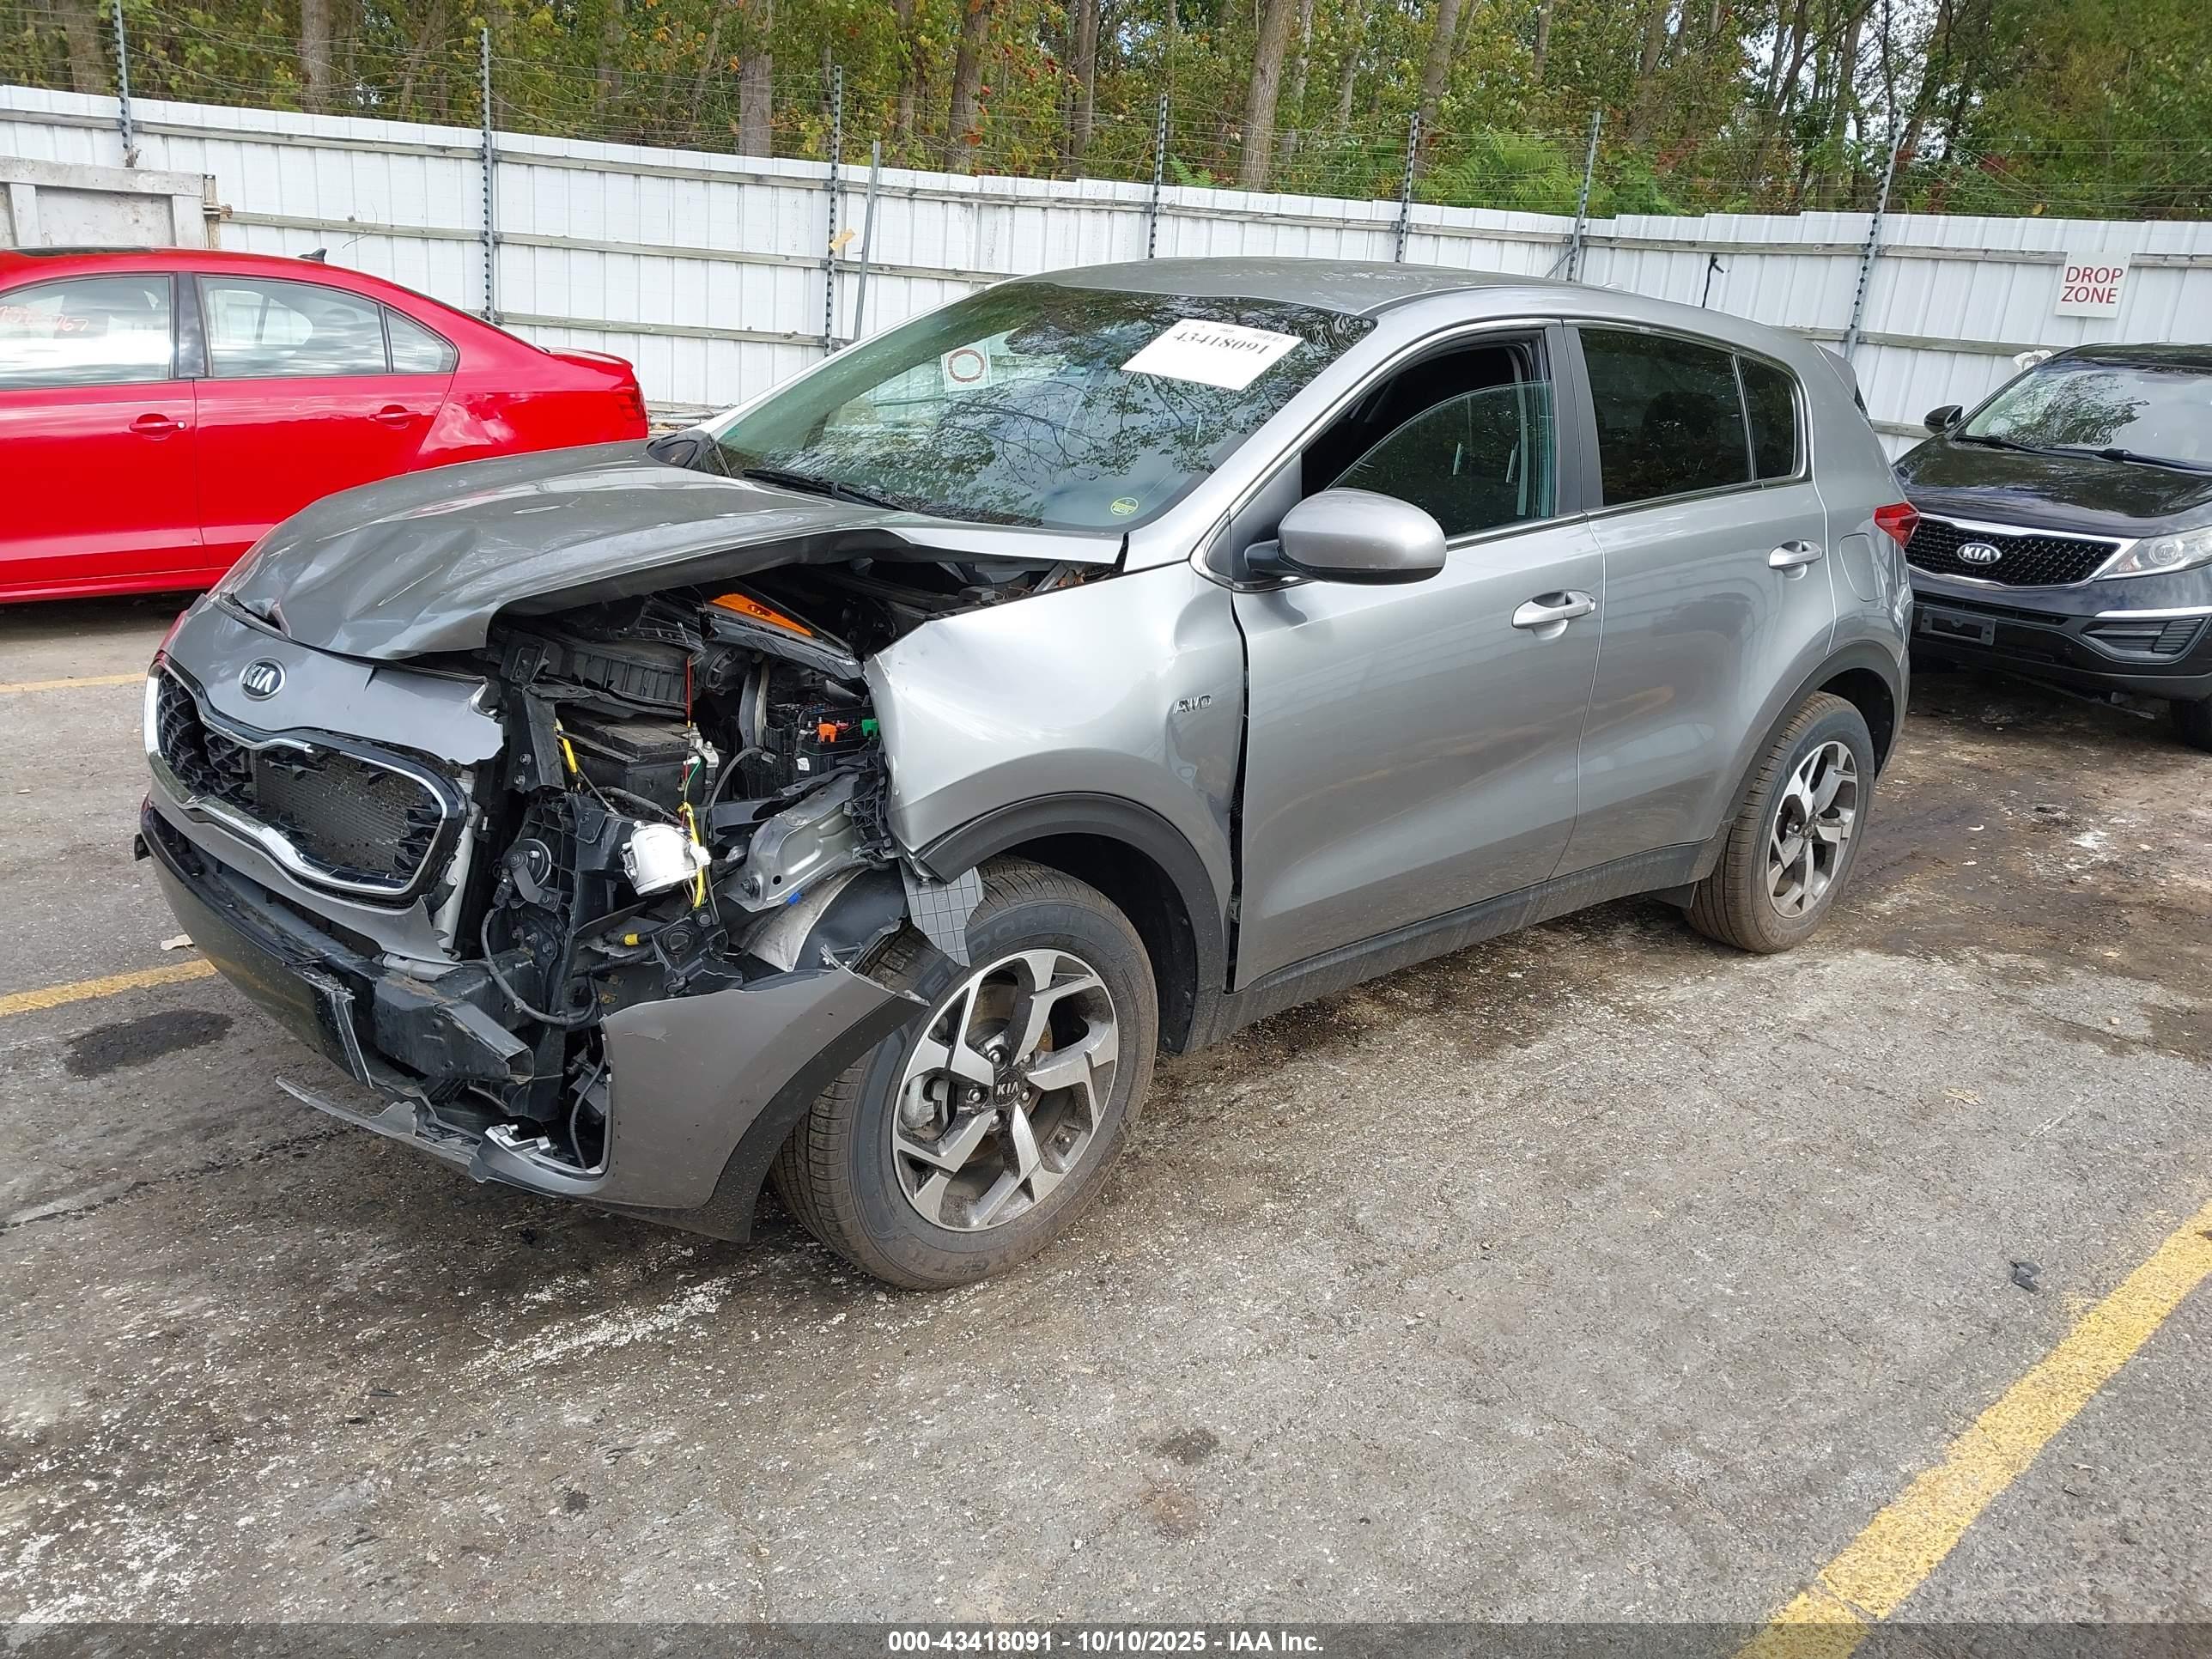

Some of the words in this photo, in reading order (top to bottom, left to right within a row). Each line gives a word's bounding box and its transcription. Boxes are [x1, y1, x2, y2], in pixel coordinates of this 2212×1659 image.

[2065, 265, 2124, 284] DROP
[2061, 285, 2118, 304] ZONE
[1173, 331, 1270, 355] 43418091
[1962, 545, 1991, 562] KIA
[242, 664, 276, 693] KIA
[997, 1081, 1019, 1096] KIA
